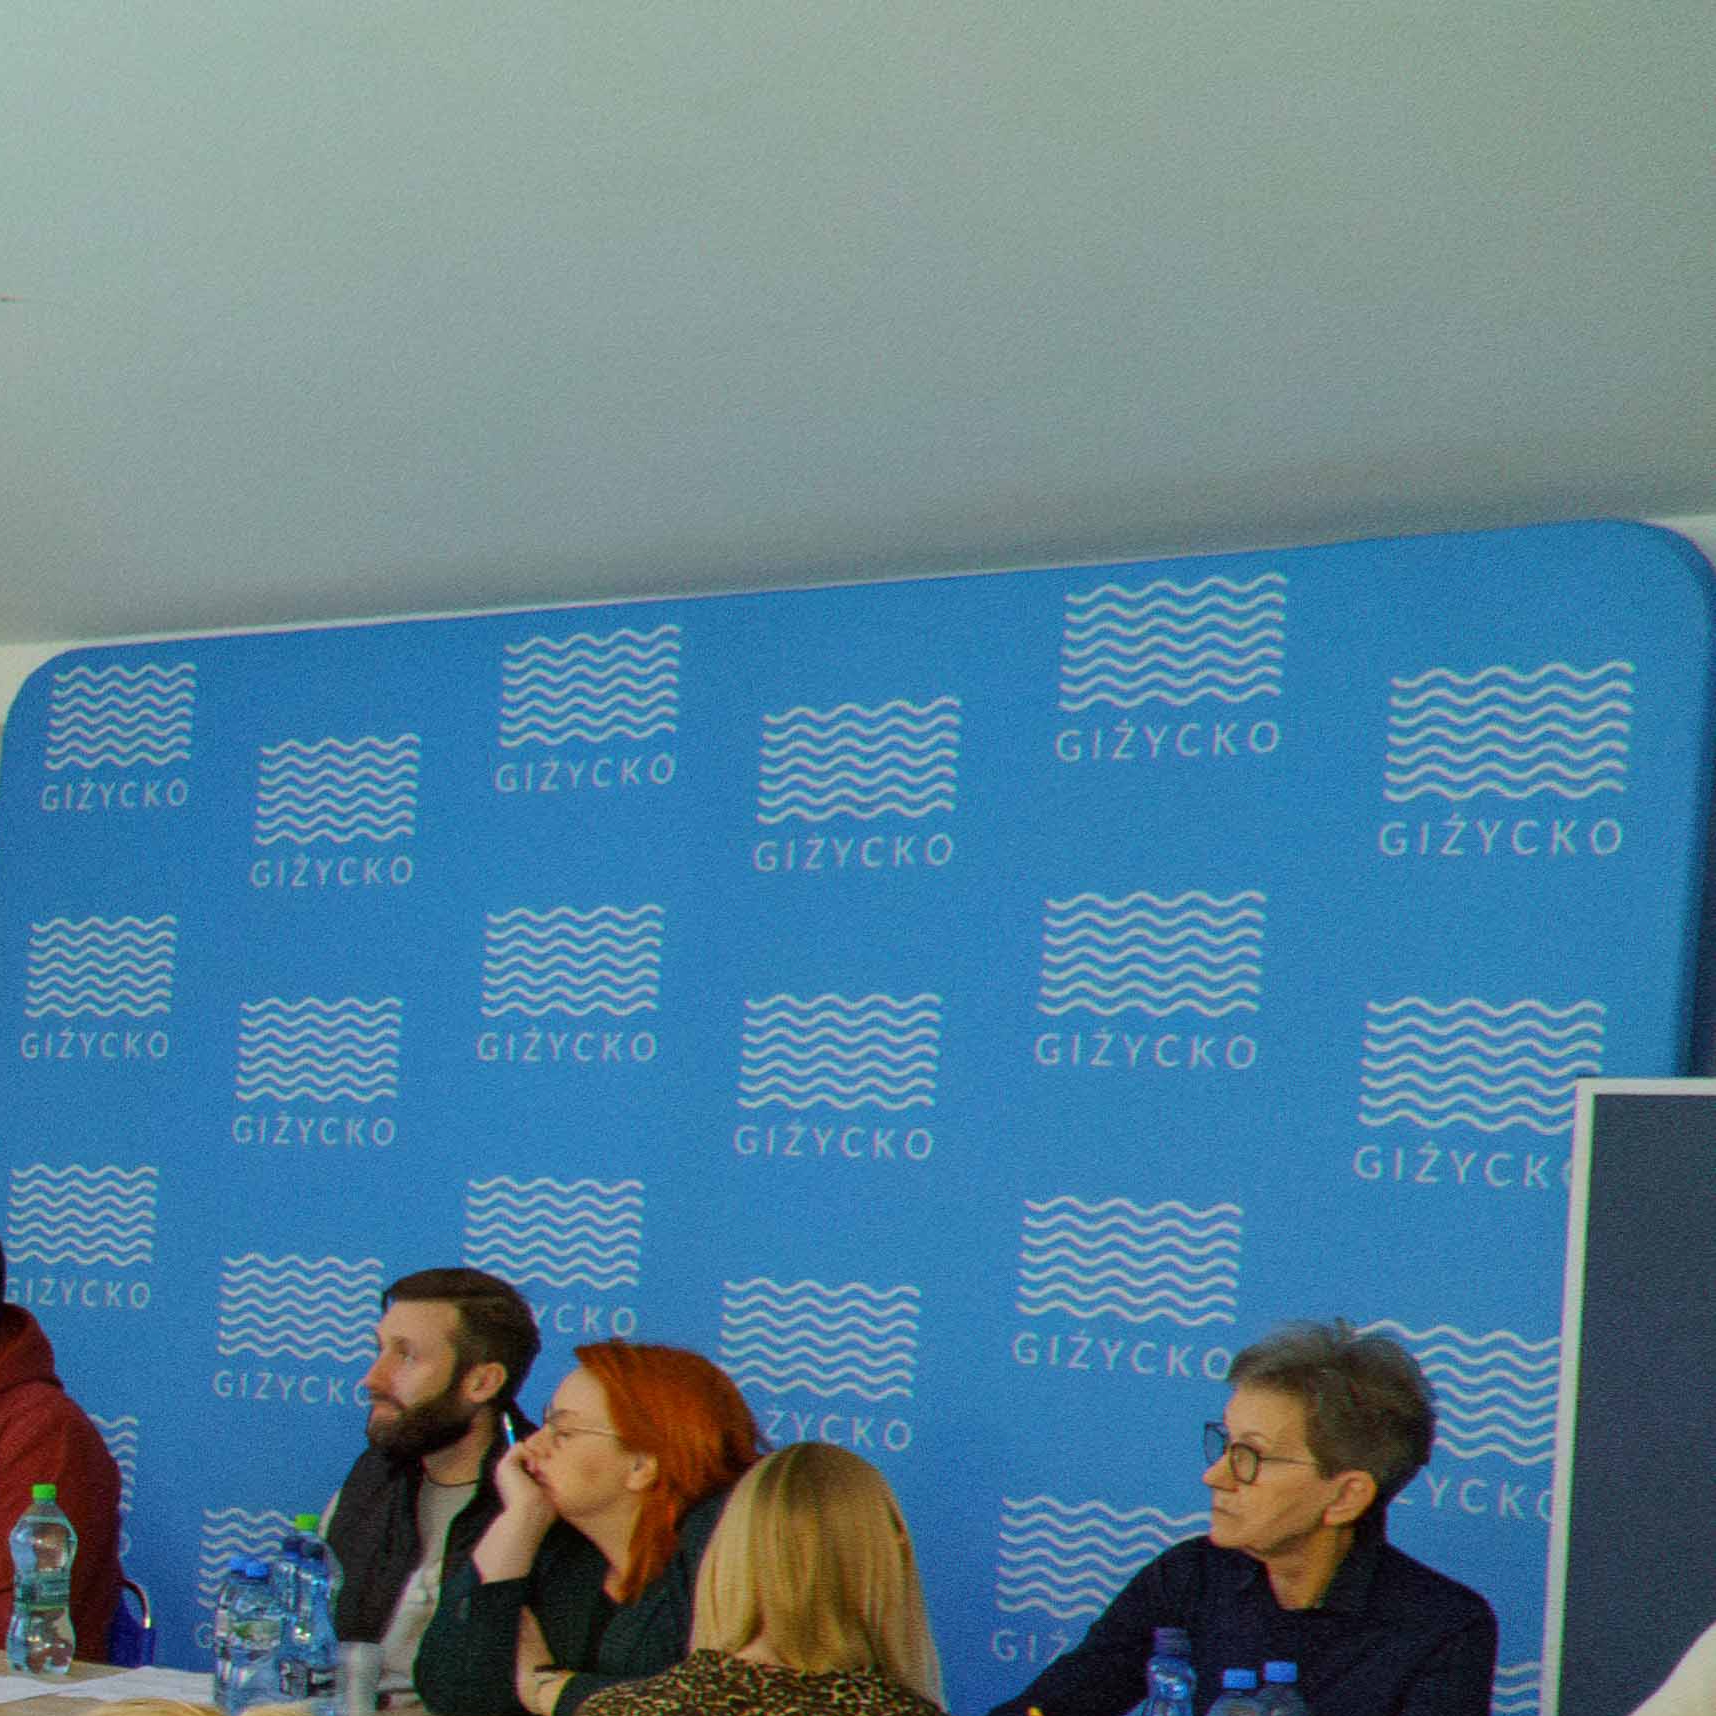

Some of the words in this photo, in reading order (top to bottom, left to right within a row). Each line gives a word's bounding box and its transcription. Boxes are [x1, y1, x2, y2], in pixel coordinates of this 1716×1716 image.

[1052, 718, 1280, 763] GIŻYCKO
[492, 753, 676, 794] GIŻYCKO
[40, 776, 189, 813] GIŻYCKO
[751, 832, 955, 873] GIŻYCKO
[1377, 811, 1624, 858] GIŻYCKO
[248, 853, 414, 889] GIŻYCKO
[20, 1028, 170, 1061] GIŻYCKO
[473, 1027, 657, 1063] GIŻYCKO
[1032, 1028, 1258, 1071] GIŻYCKO
[230, 1112, 397, 1148] GIŻYCKO
[731, 1121, 934, 1162] GIŻYCKO
[1352, 1139, 1573, 1189] GIŻYCK
[530, 1303, 637, 1338] YCKO
[1012, 1328, 1234, 1381] GIŻYCKO
[763, 1403, 913, 1452] ŻYCKO
